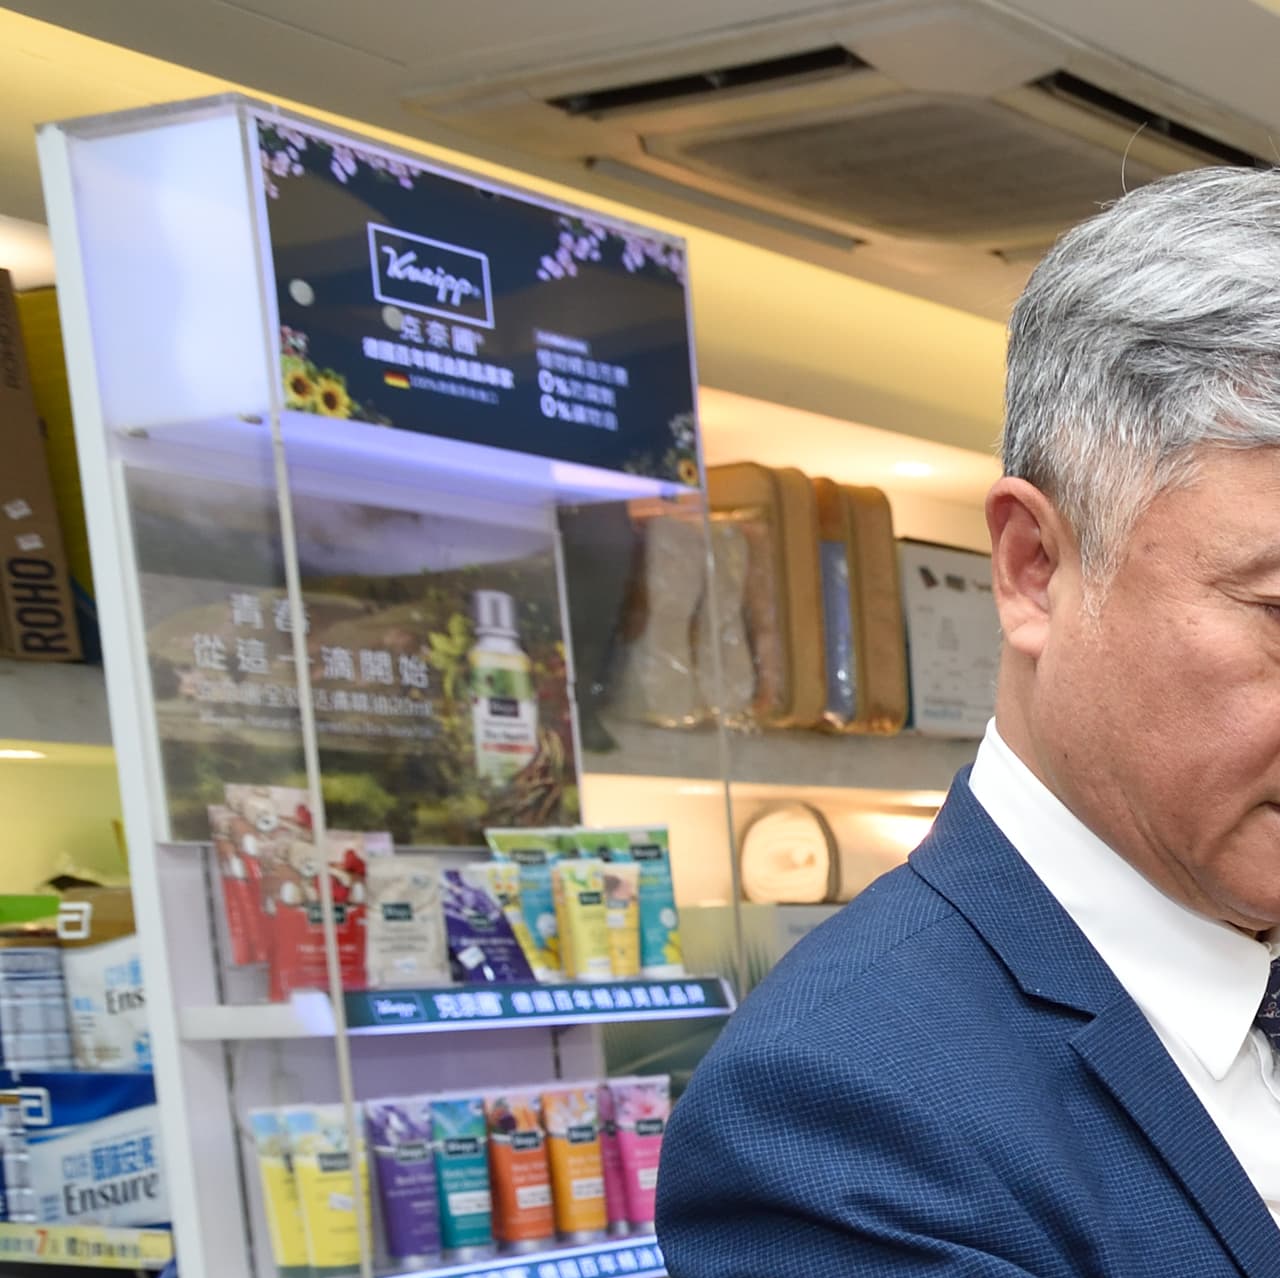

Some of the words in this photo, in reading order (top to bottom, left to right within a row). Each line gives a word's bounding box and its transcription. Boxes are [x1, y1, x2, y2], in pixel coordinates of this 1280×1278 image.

[381, 245, 480, 307] Kneipp
[6, 557, 71, 656] ROHO
[104, 982, 147, 1016] Ens
[62, 1171, 160, 1216] Ensure
